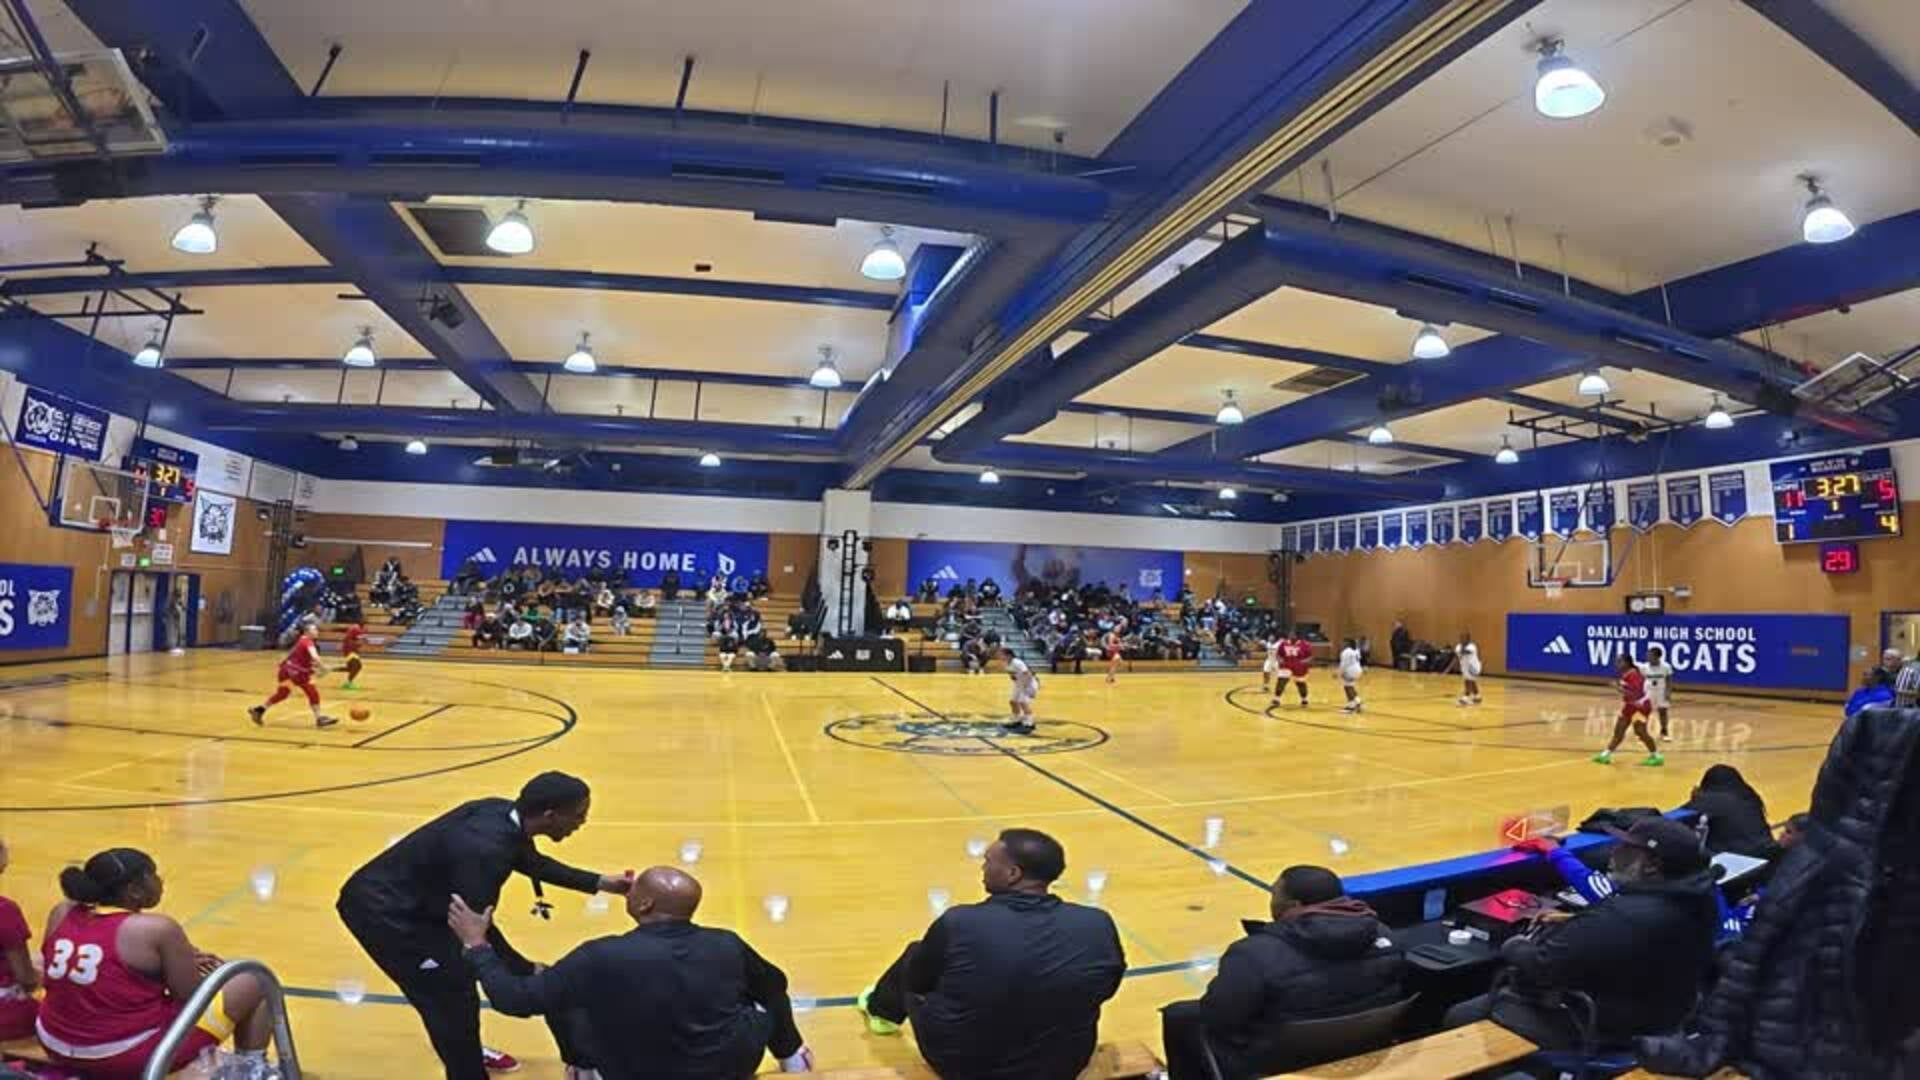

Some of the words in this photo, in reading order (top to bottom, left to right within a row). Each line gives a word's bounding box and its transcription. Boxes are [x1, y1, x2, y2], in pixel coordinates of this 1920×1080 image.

[1877, 479, 1895, 499] 5
[1788, 523, 1794, 539] 1
[1880, 515, 1898, 532] 4
[513, 546, 612, 568] ALWAYS
[623, 551, 697, 572] HOME
[1825, 551, 1851, 571] 29
[1587, 625, 1649, 639] OAKLAND
[1653, 626, 1690, 640] HIGH
[1695, 627, 1757, 641] SCHOOL
[47, 938, 103, 985] 33
